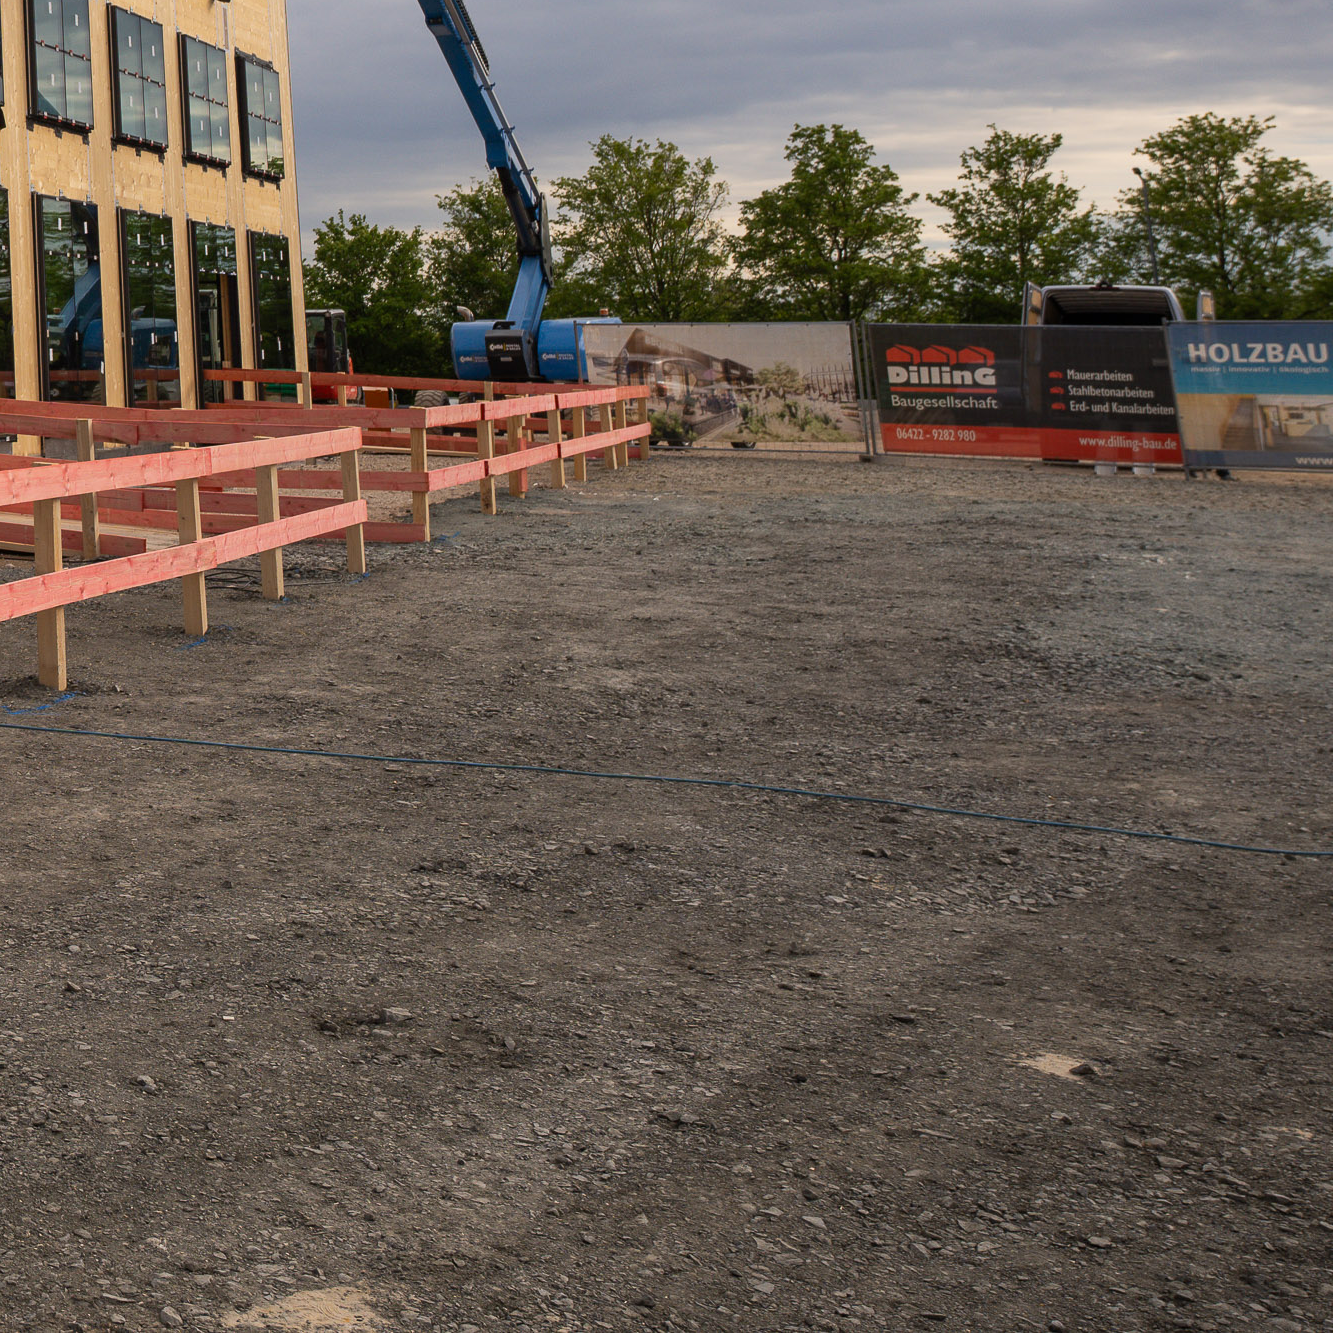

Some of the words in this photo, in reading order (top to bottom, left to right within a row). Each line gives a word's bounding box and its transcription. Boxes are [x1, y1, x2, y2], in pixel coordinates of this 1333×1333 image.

[1187, 342, 1329, 364] HOLZBAU
[1066, 368, 1133, 382] Mauerarbeiten
[1278, 365, 1329, 375] ökologisch
[1067, 384, 1155, 399] Stahlbetonarbeiten
[890, 394, 998, 411] Baugesellschaft
[1069, 400, 1090, 412] Erd-
[1091, 402, 1109, 413] und
[1111, 401, 1175, 415] Kanalarbeiten
[896, 427, 924, 440] 06422
[932, 429, 955, 441] 9282
[957, 430, 976, 442] 980
[1079, 435, 1177, 452] www.dilling-bau.de
